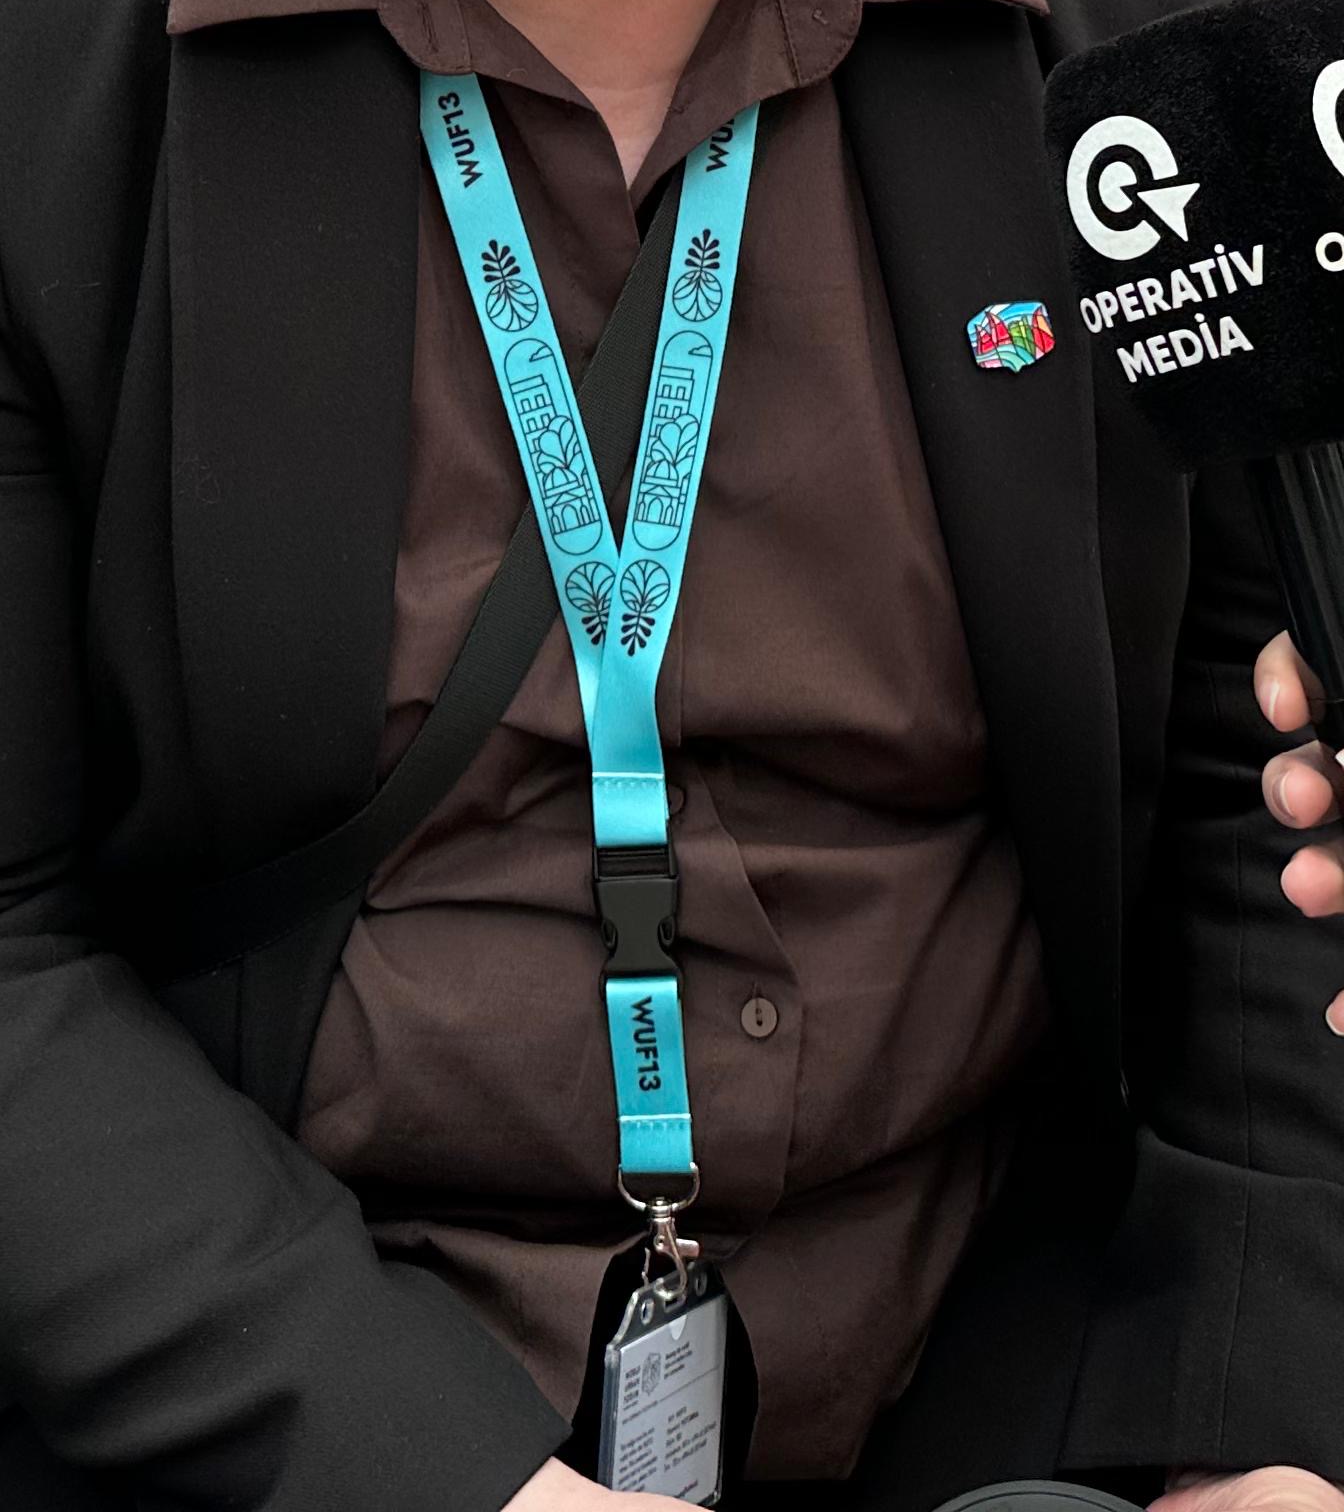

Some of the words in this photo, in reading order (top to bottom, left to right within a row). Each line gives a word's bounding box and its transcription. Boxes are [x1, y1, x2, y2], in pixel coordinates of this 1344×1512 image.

[438, 91, 483, 188] WUF13
[706, 118, 735, 173] WU
[1079, 243, 1264, 334] OPERATİV
[1116, 312, 1254, 383] MEDİA
[631, 996, 662, 1092] WUF13
